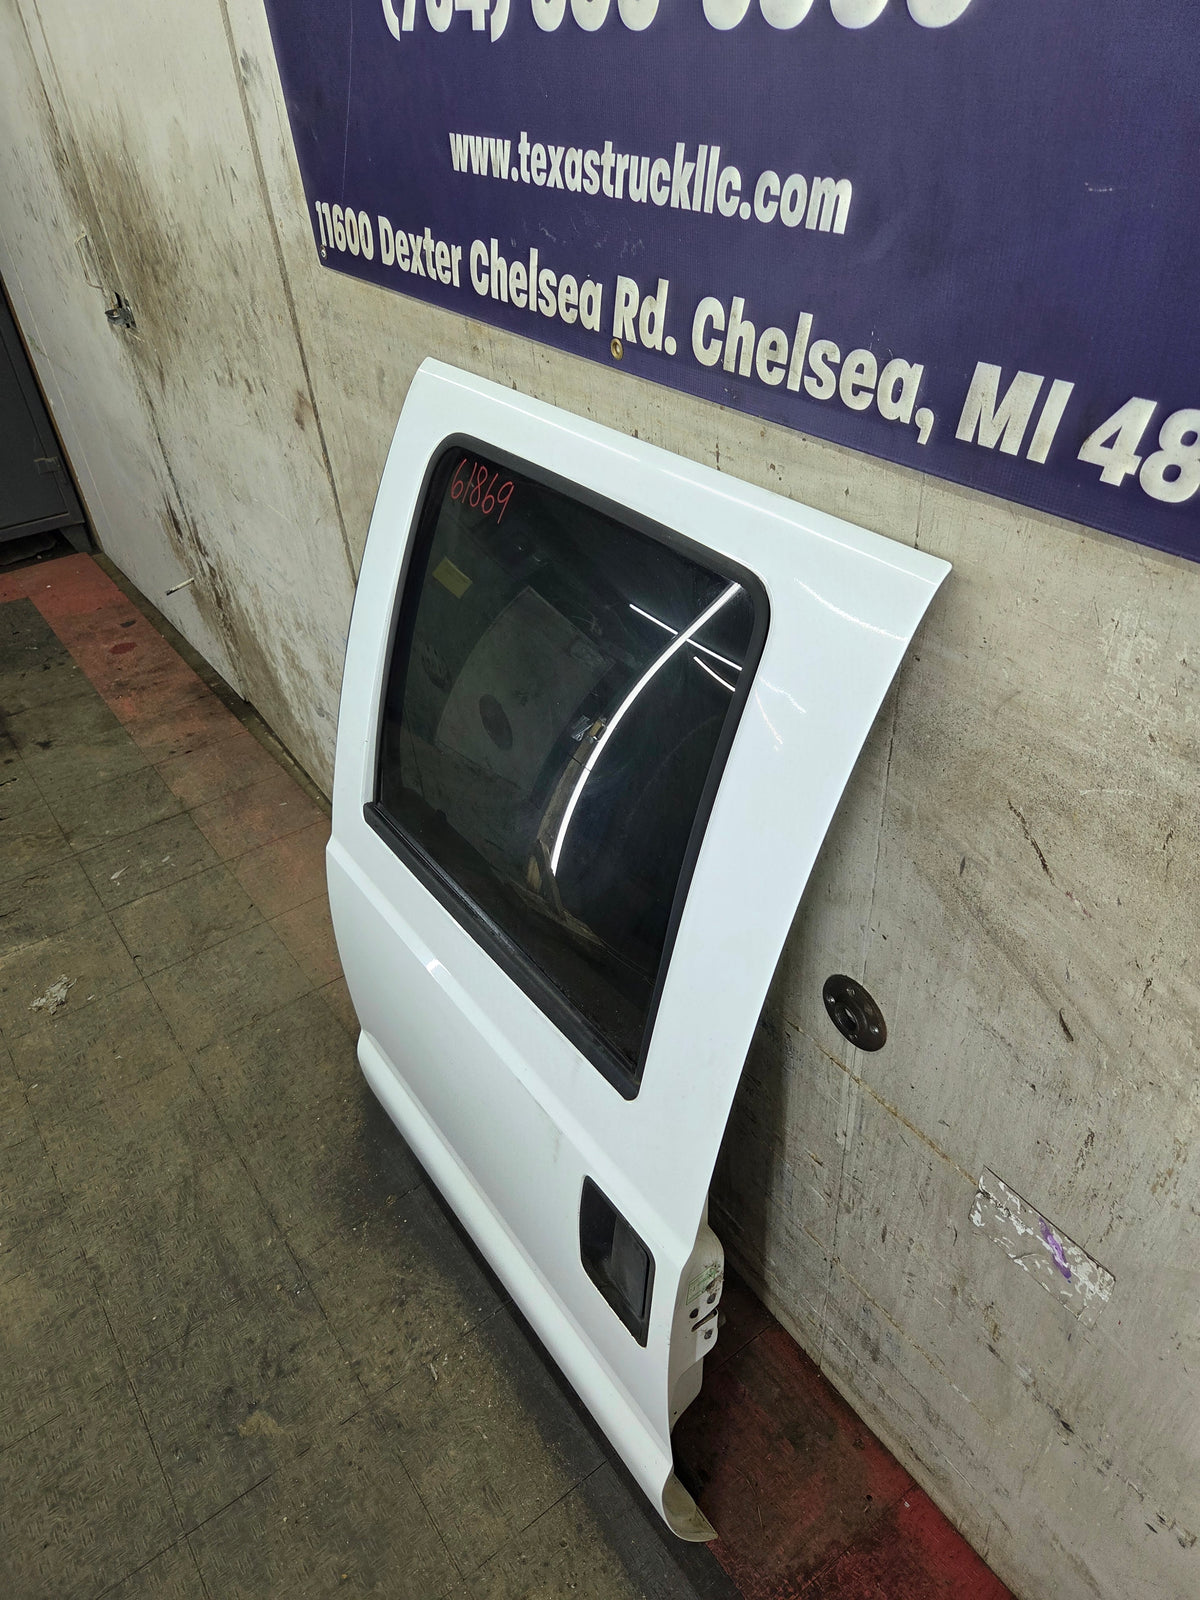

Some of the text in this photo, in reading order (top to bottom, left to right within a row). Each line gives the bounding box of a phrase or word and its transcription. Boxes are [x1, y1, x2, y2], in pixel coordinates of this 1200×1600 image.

[448, 130, 853, 235] www.texastruckllc.com
[314, 200, 374, 261] 11600
[377, 215, 462, 288] Dexter
[469, 237, 603, 333] Chelsea
[612, 274, 677, 356] Rd.
[691, 295, 935, 446] Chelsea,
[955, 361, 1075, 465] MI
[451, 458, 515, 525] 61869
